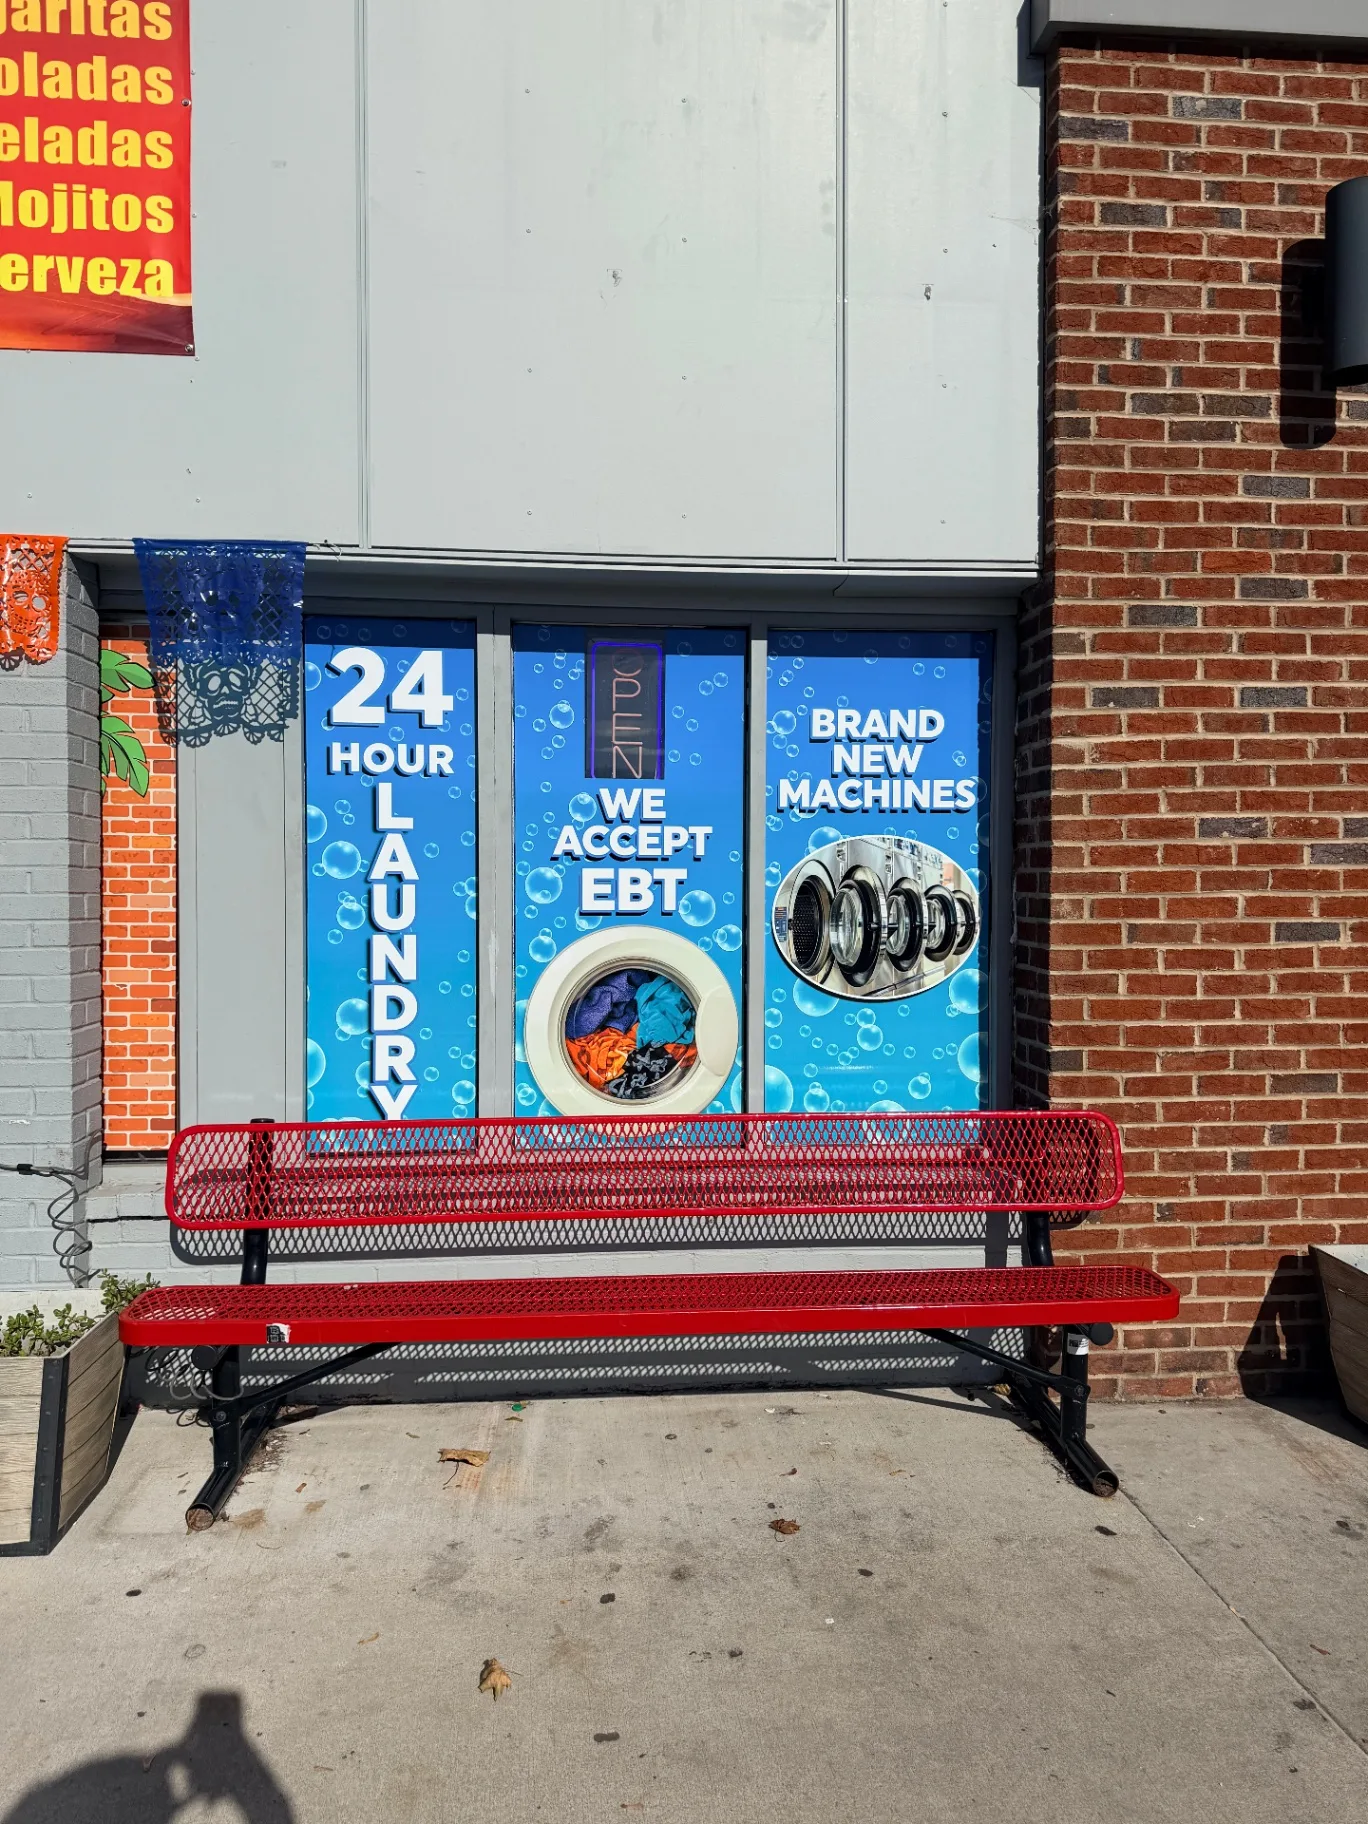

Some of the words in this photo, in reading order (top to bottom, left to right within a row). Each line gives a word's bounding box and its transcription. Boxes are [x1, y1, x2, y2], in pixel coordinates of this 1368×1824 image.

[0, 0, 173, 41] aritas
[0, 253, 174, 297] erveza
[329, 647, 454, 727] 24
[612, 648, 644, 779] OPEN
[811, 709, 945, 739] BRAND
[331, 743, 454, 774] HOUR
[833, 744, 923, 773] NEW
[600, 788, 666, 819] WE
[779, 779, 977, 809] MACHINES
[553, 826, 713, 856] ACCEPT
[581, 868, 688, 913] EBT
[370, 782, 419, 1131] LAUNDRY
